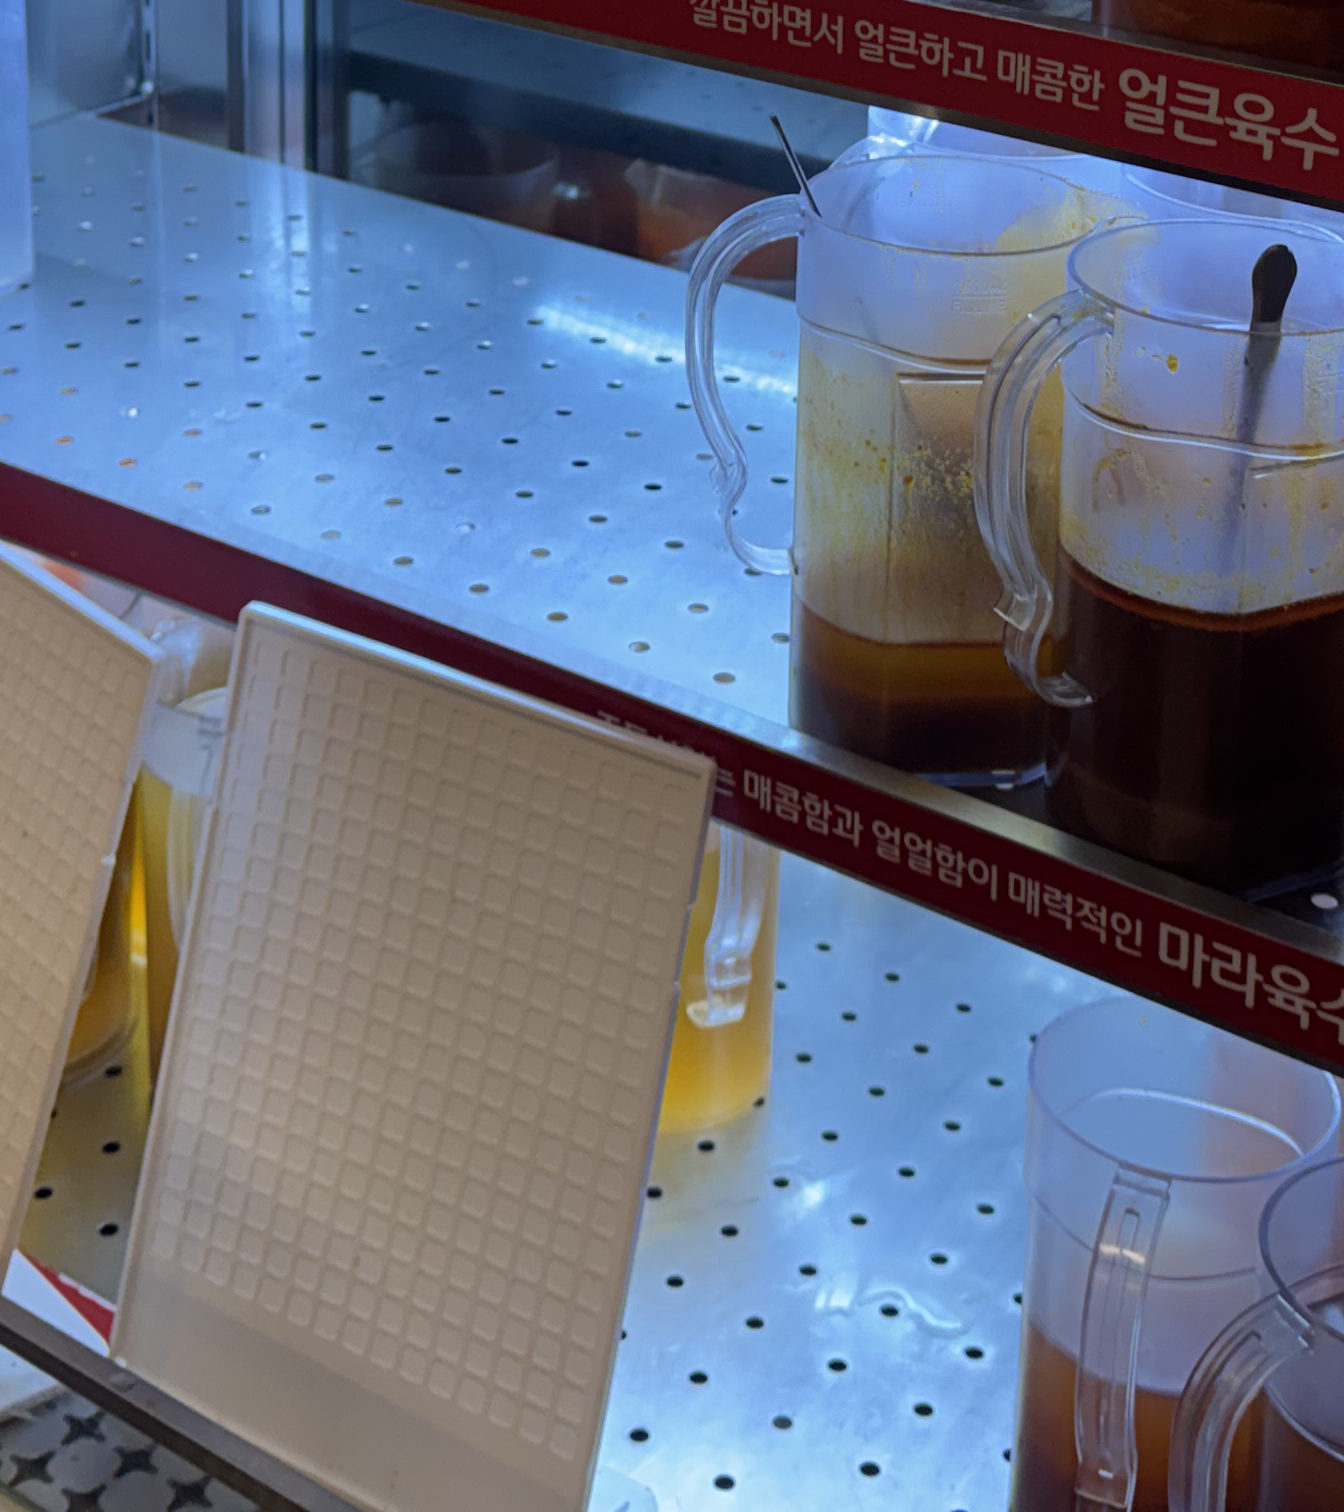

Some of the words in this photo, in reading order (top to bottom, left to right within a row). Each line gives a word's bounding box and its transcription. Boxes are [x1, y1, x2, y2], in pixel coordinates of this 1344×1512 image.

[854, 19, 987, 82] 얼큰하고
[996, 52, 1105, 111] 매콤한
[1118, 68, 1340, 170] 얼큰육수
[743, 768, 864, 848] 매콤함과
[871, 818, 999, 903] 얼얼함이
[1007, 872, 1143, 957] 매력적인
